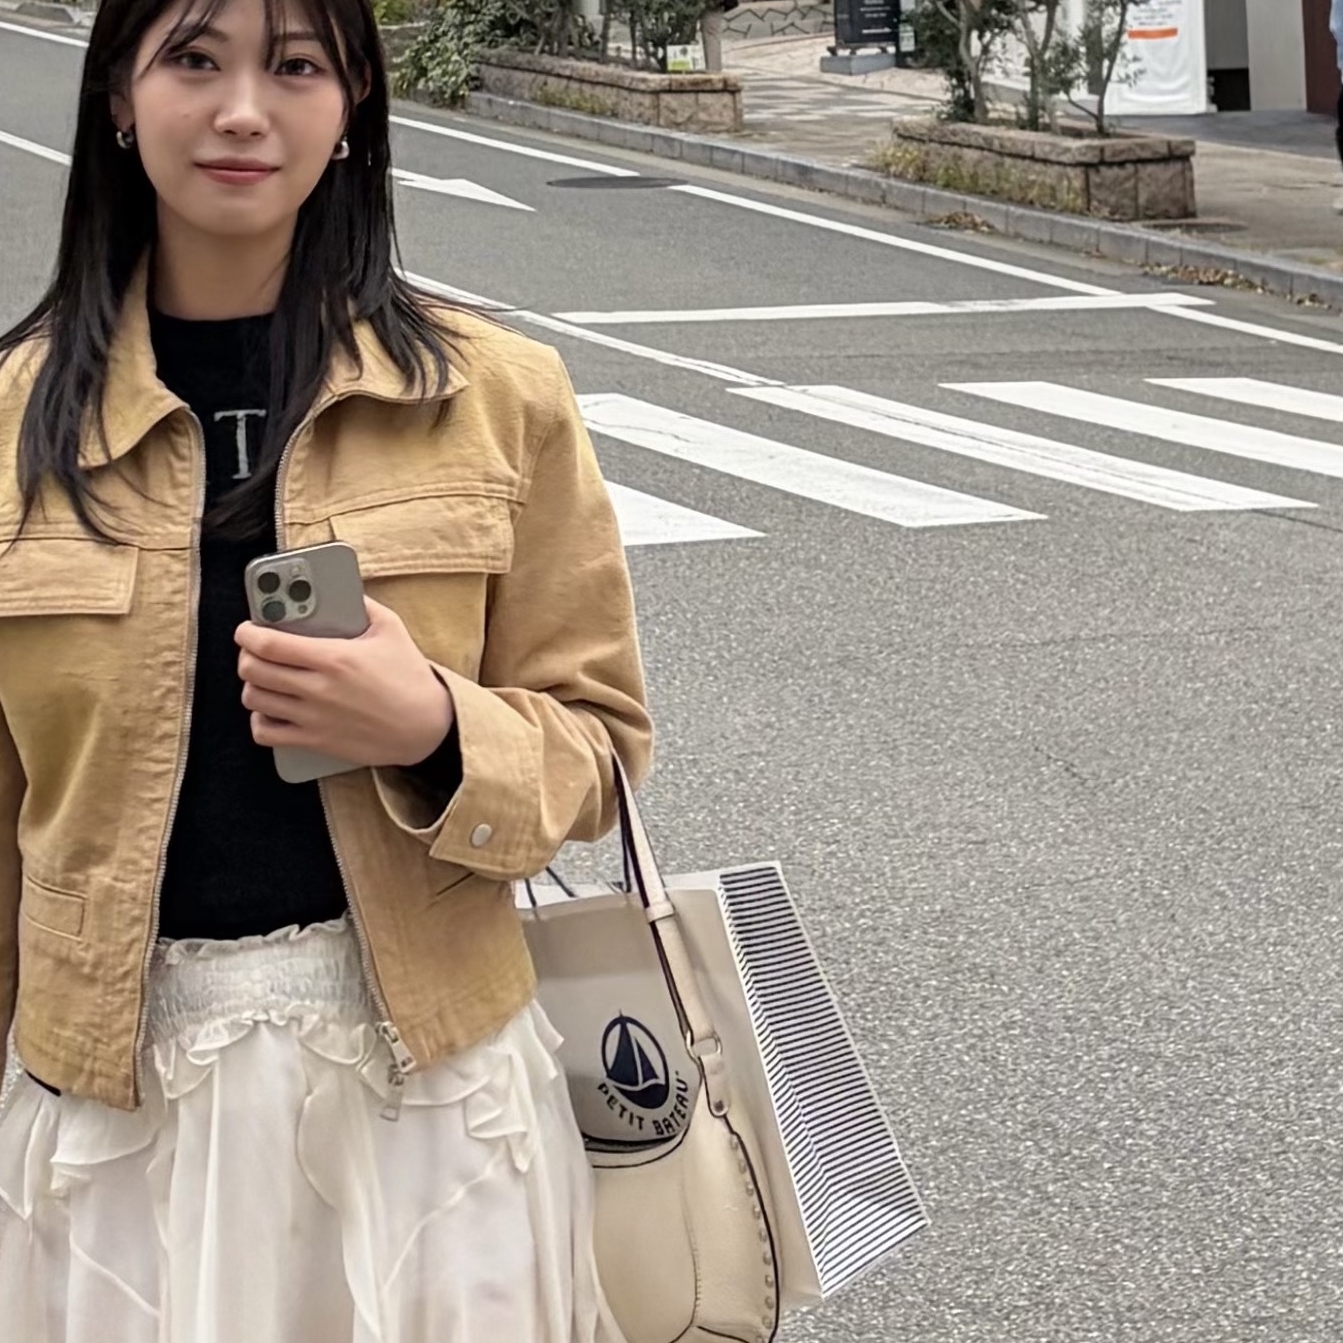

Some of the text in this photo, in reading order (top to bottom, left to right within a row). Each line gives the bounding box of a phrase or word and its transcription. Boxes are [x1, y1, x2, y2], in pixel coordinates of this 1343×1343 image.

[213, 409, 267, 480] T
[597, 1077, 689, 1136] PETIT BATEAU
